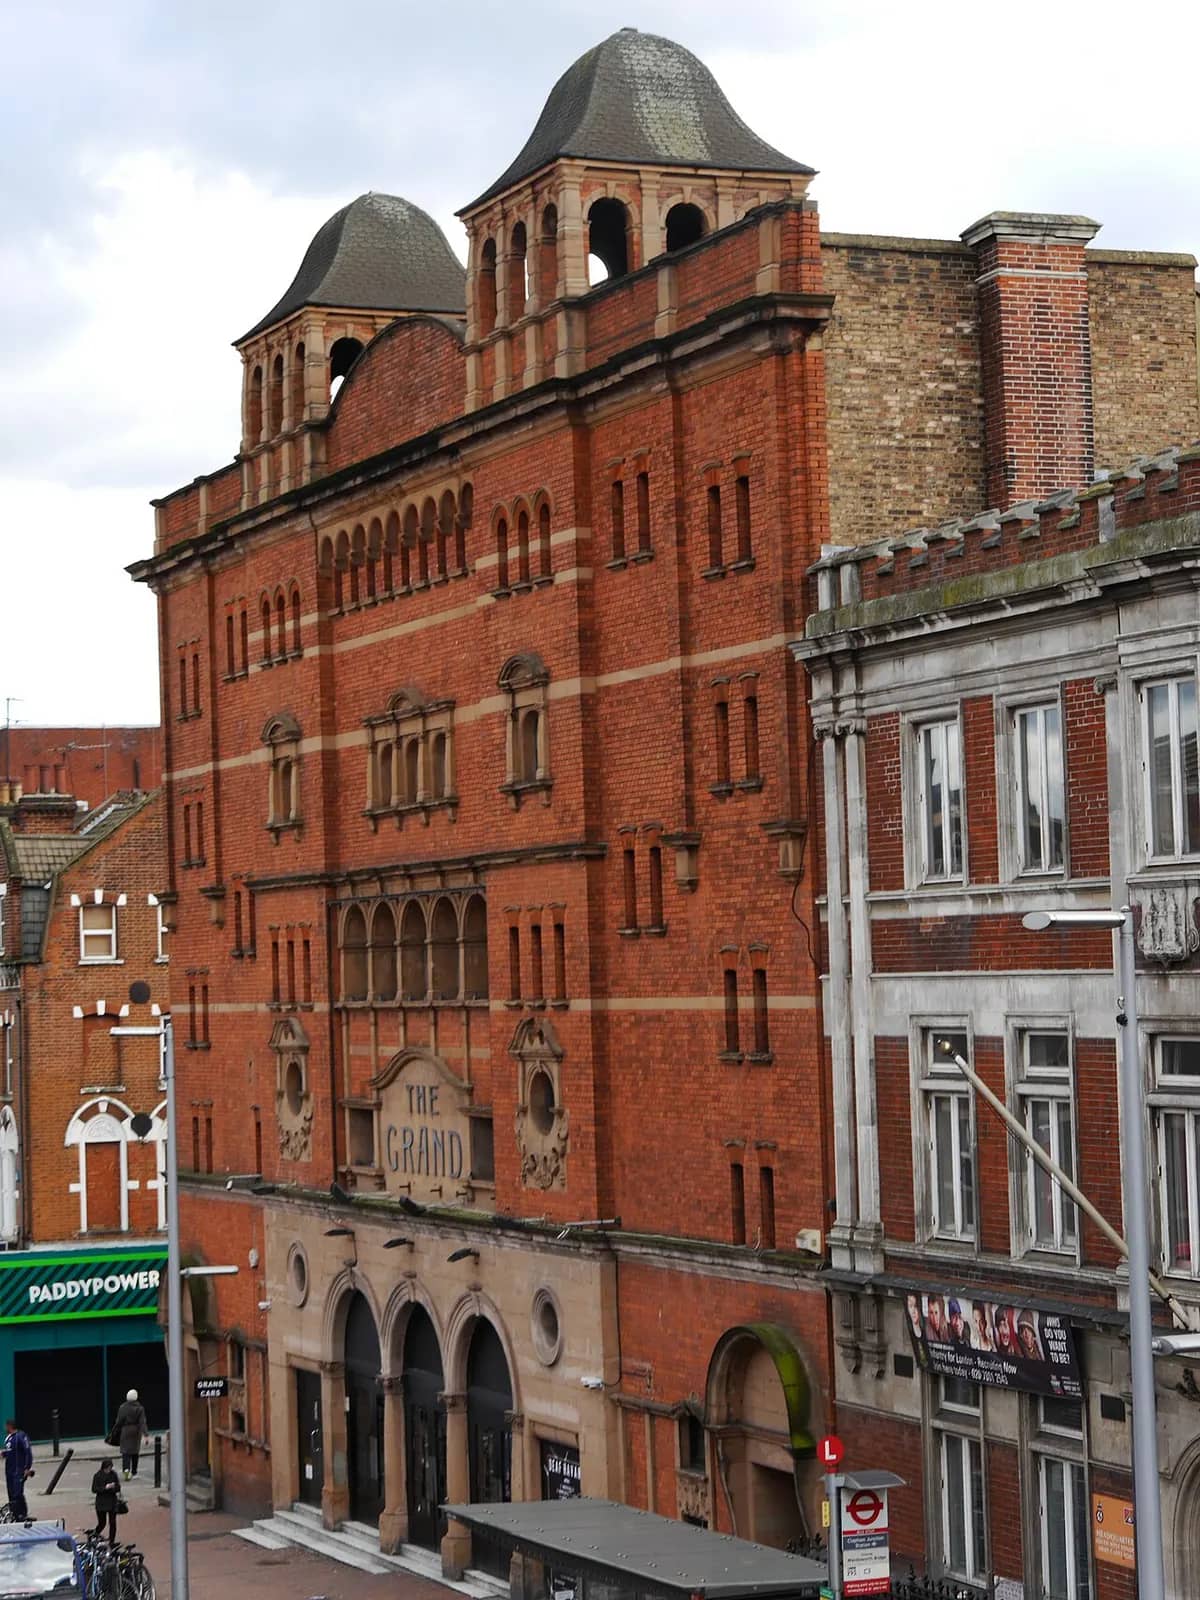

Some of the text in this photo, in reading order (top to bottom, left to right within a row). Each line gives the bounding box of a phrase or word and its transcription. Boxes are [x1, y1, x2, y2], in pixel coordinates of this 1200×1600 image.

[405, 1084, 440, 1119] THE
[386, 1124, 463, 1179] GRAND
[29, 1270, 160, 1304] PADDYPOWER
[1044, 1328, 1067, 1340] DO YOU
[1048, 1340, 1067, 1352] WANT
[956, 1353, 974, 1366] London
[1003, 1361, 1017, 1375] Now
[1050, 1352, 1070, 1364] TO BE?
[197, 1380, 224, 1389] GRAND
[824, 1440, 837, 1461] L
[548, 1458, 561, 1474] DEAF
